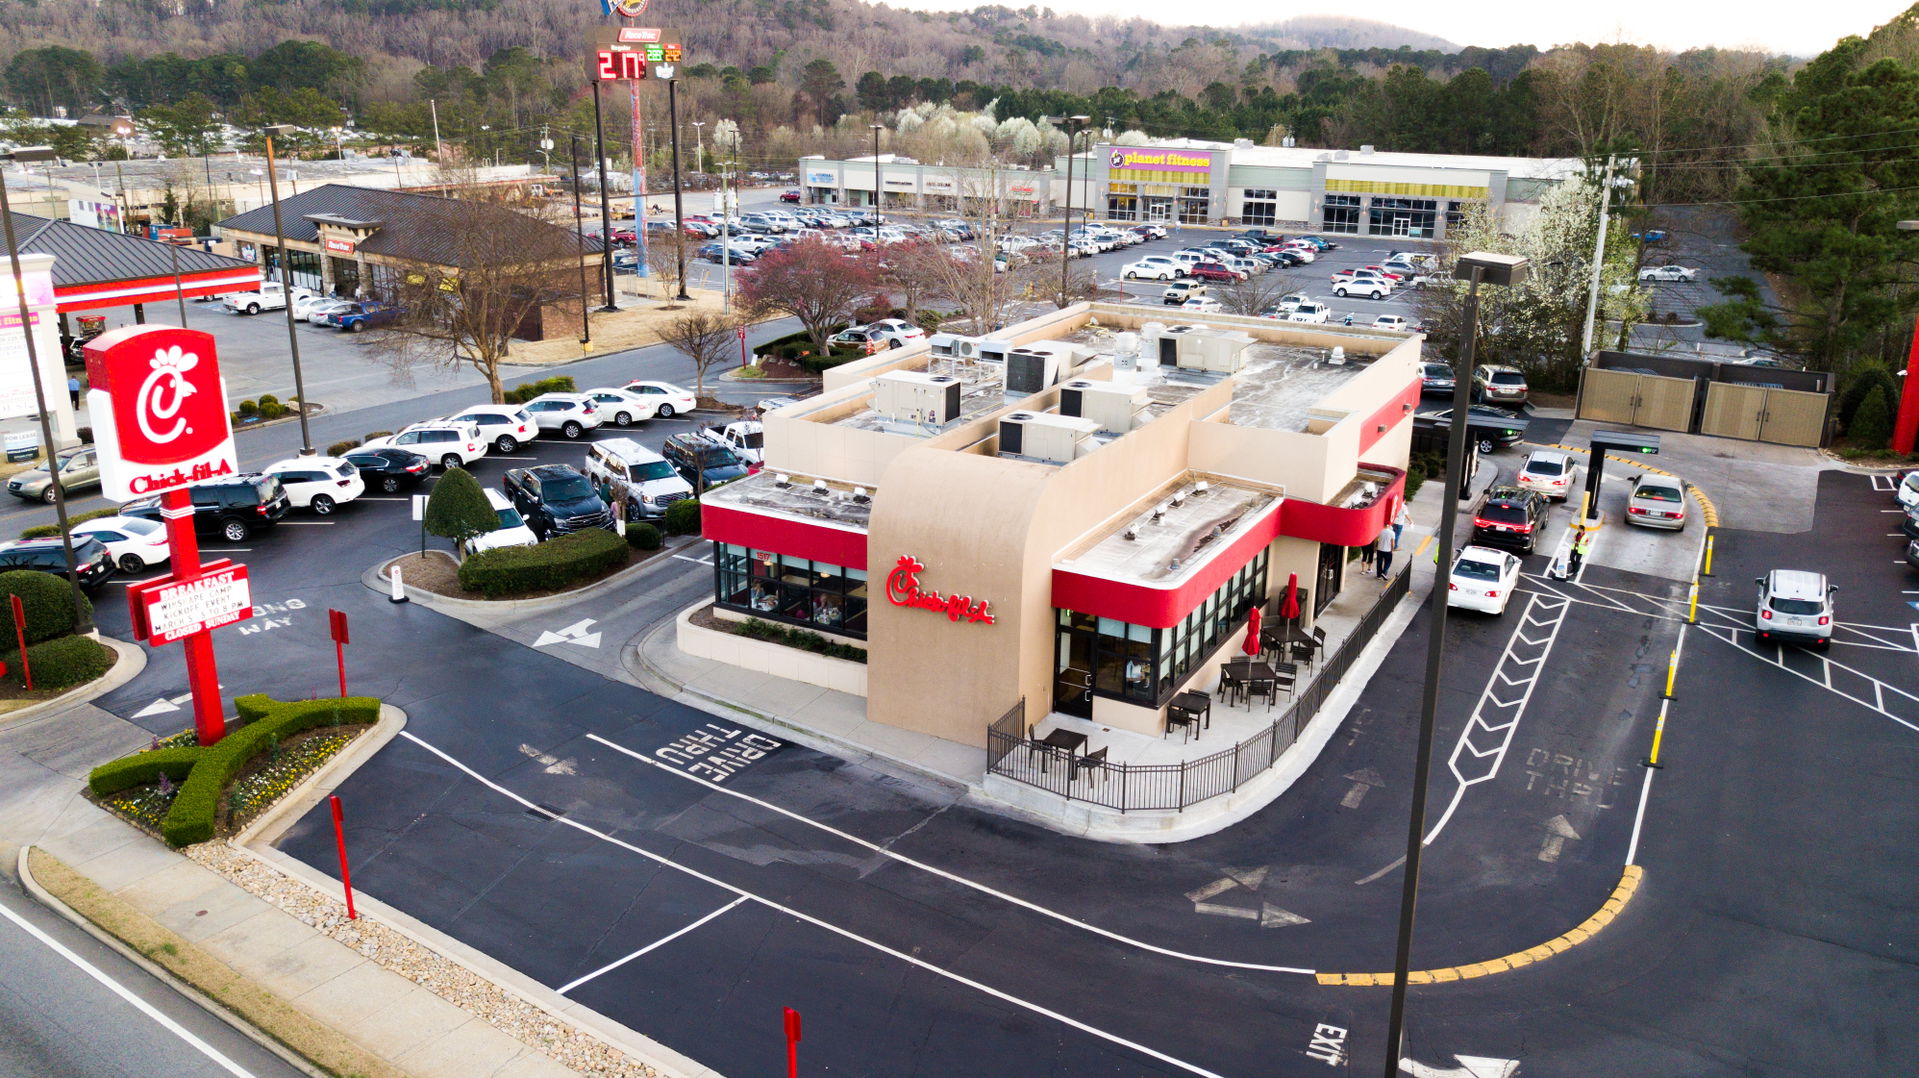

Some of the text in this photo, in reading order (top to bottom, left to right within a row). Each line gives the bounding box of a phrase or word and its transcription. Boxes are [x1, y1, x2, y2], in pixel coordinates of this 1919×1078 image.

[1124, 152, 1210, 167] planet fitness
[129, 458, 233, 494] Chick-fil-A
[159, 572, 234, 601] BREAKFAST
[209, 585, 232, 599] CAMP
[155, 618, 185, 633] MARCH
[231, 600, 244, 610] PM
[164, 595, 230, 620] KICKOFF EVENT
[164, 611, 241, 641] CLOSED SUNDAY
[239, 613, 293, 636] WAY
[655, 723, 742, 765] THRU
[688, 733, 782, 782] DRIVE
[1306, 1022, 1347, 1067] EXIT
